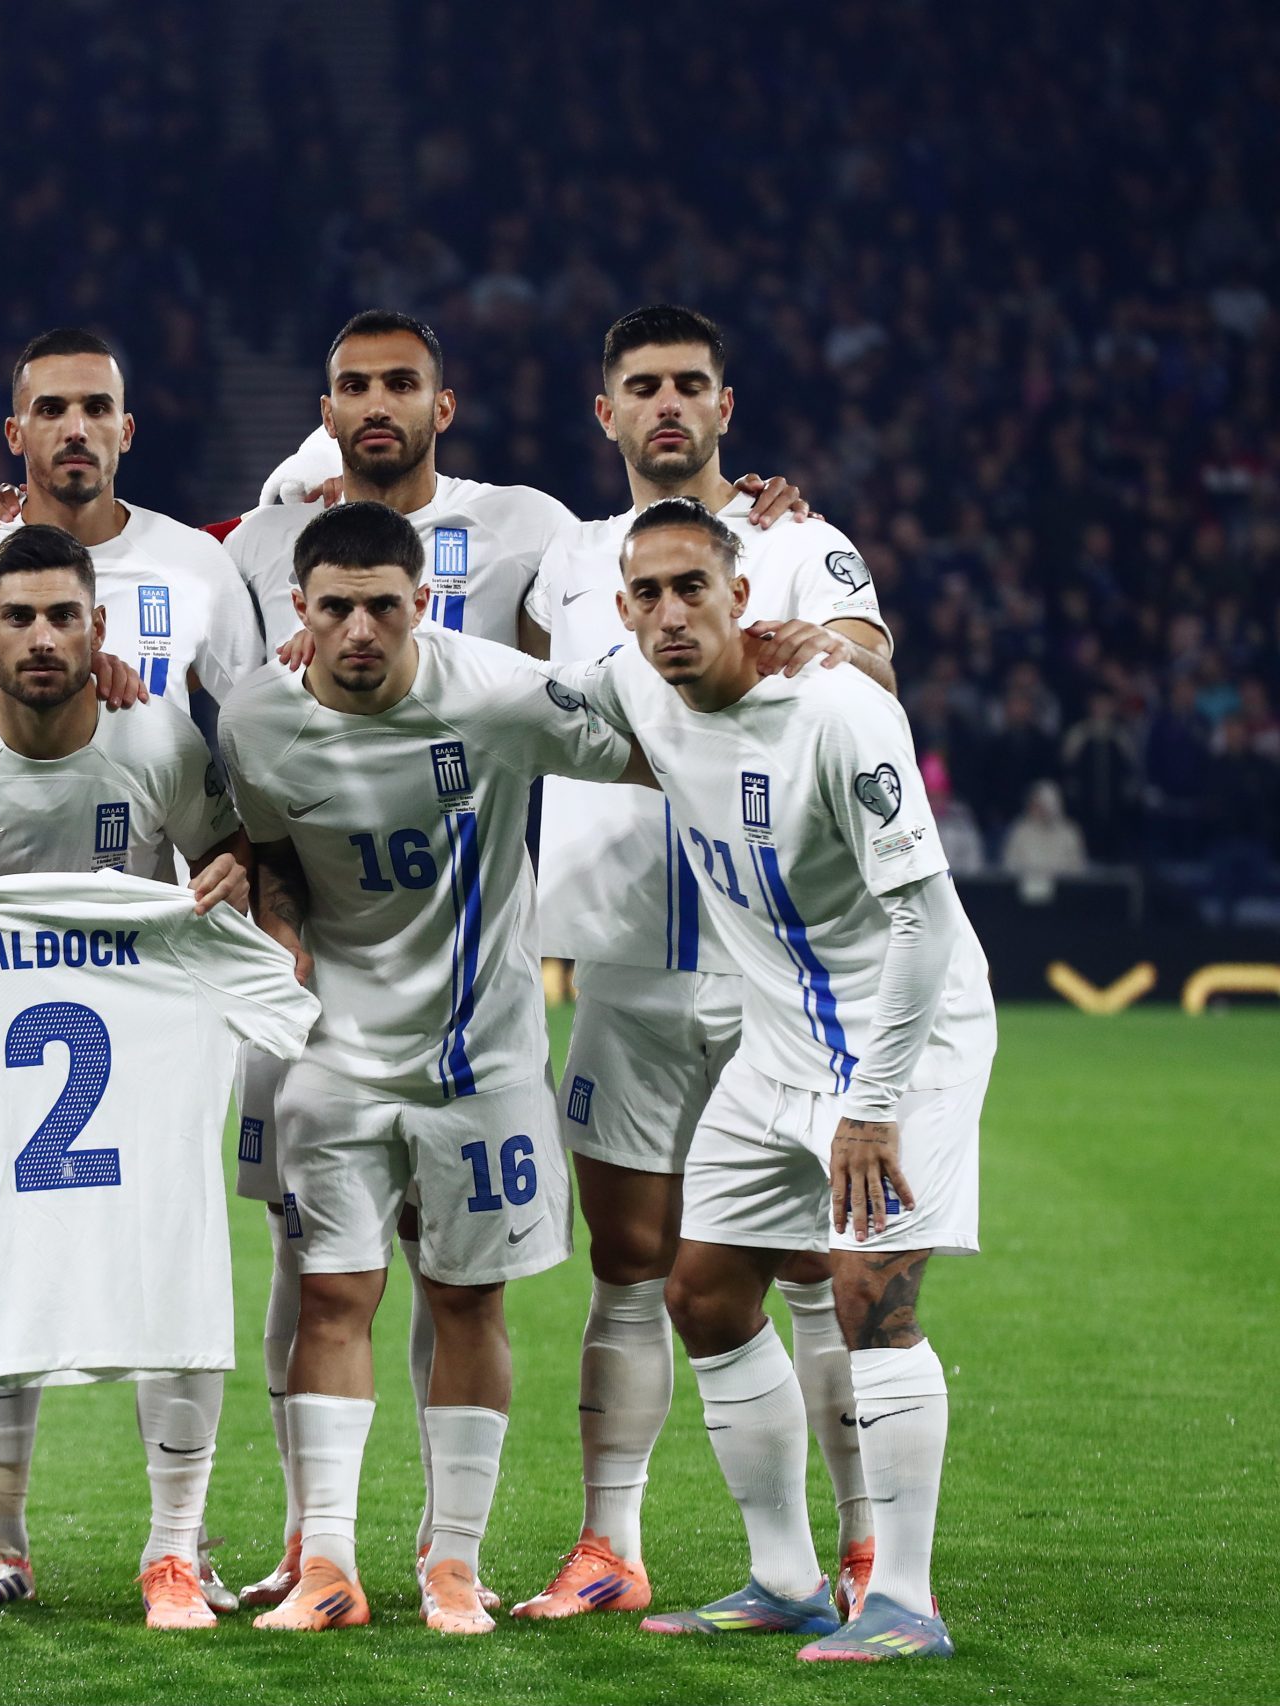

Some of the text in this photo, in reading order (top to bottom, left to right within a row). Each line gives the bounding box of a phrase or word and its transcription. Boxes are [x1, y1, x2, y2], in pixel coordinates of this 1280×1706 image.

[348, 828, 438, 892] 16
[5, 1001, 121, 1192] 2
[461, 1134, 538, 1213] 16
